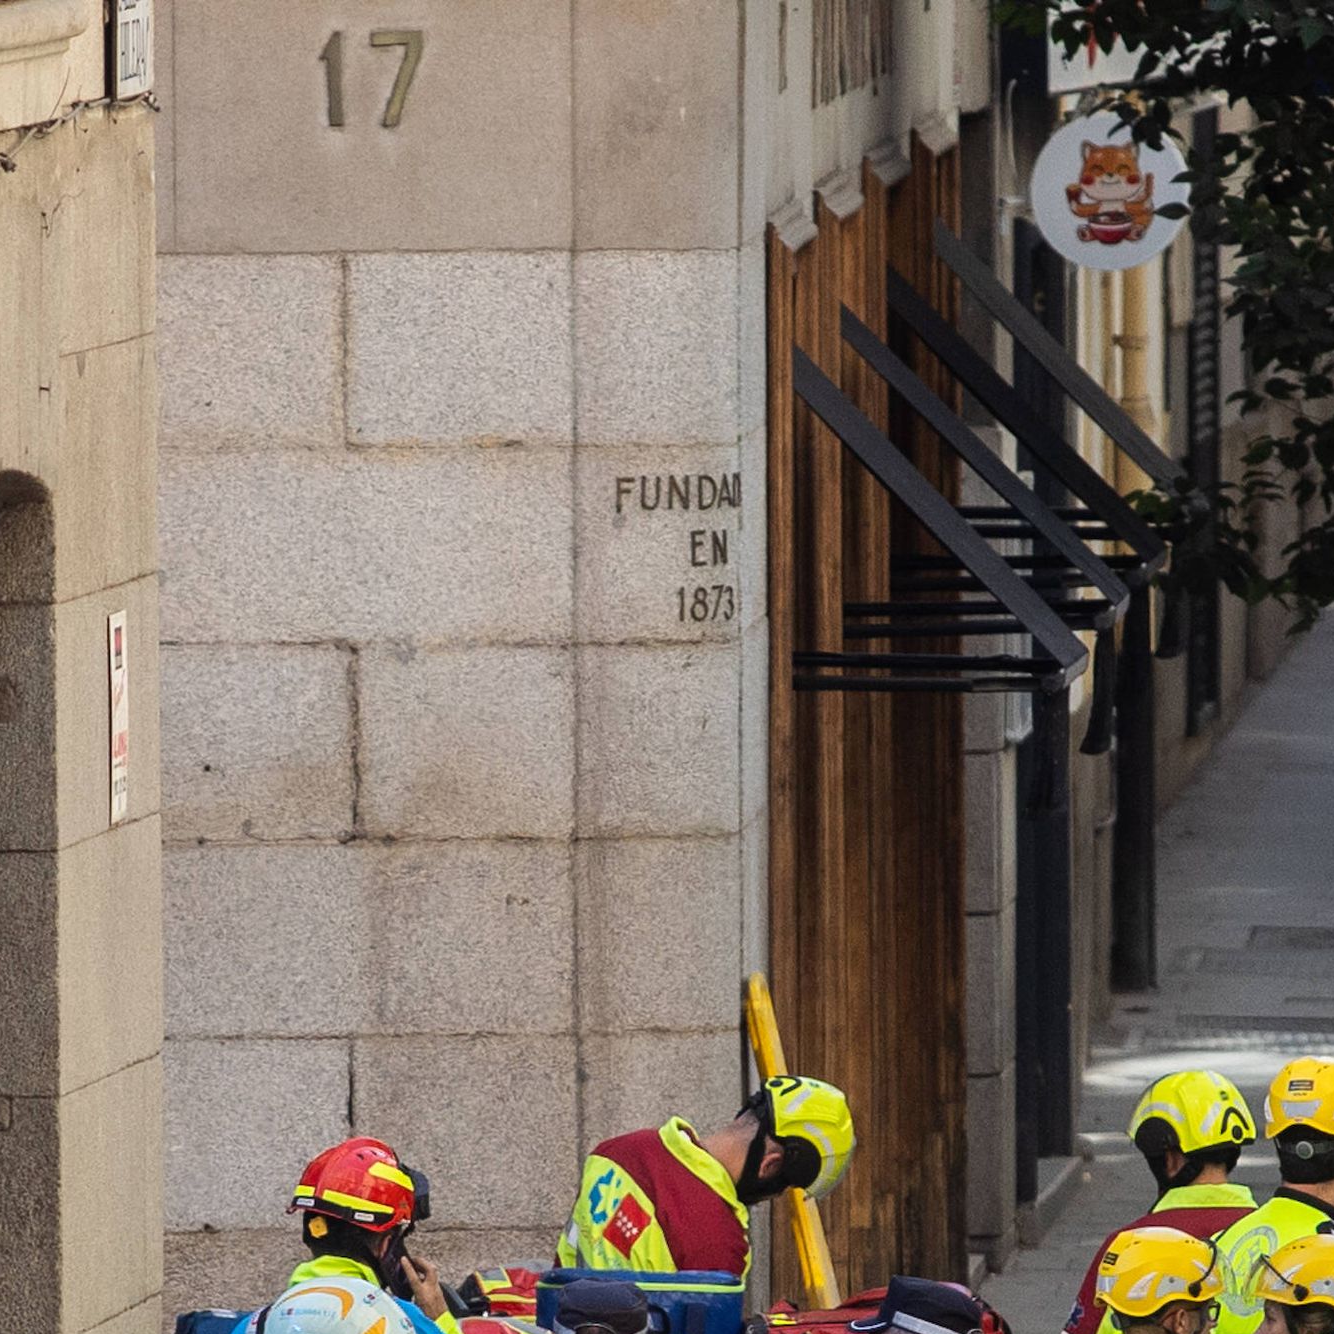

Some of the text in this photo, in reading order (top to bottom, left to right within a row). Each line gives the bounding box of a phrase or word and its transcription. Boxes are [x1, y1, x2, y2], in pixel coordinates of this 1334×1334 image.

[318, 28, 425, 129] 17
[690, 529, 728, 567] EN
[678, 584, 735, 622] 1873
